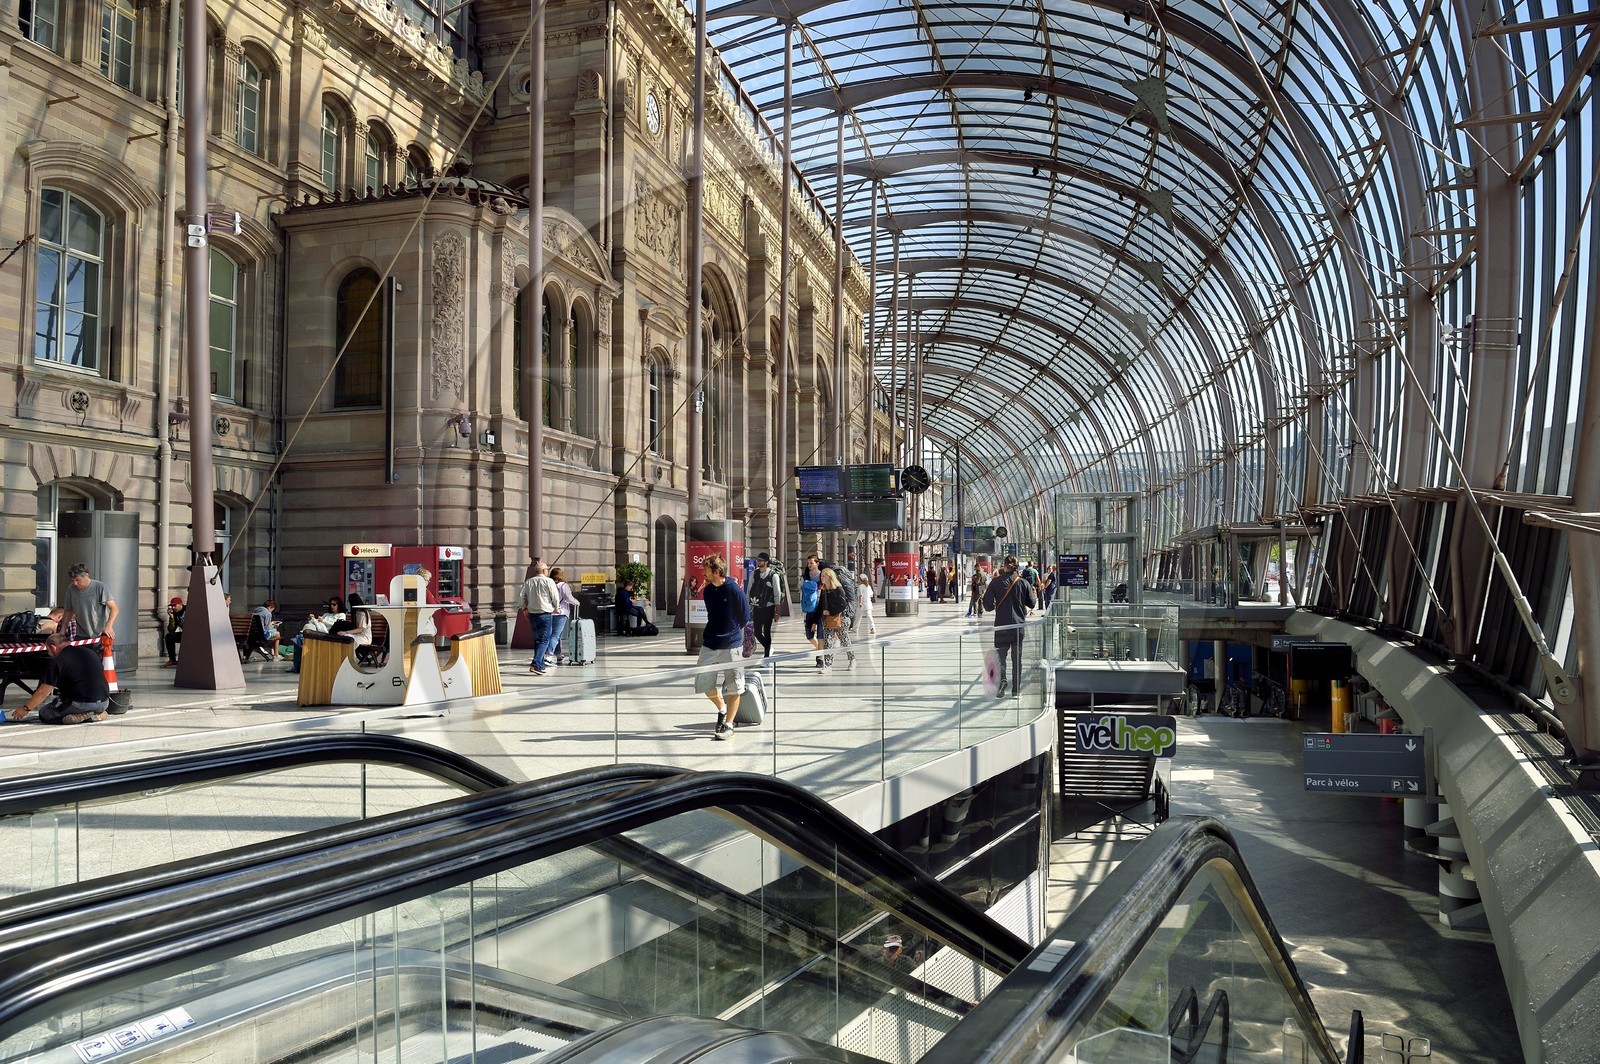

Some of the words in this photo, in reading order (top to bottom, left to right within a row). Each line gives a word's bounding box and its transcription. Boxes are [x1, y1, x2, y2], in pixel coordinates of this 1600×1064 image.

[1306, 778, 1326, 787] Parc
[1328, 778, 1333, 787] à
[1335, 778, 1359, 788] vélos
